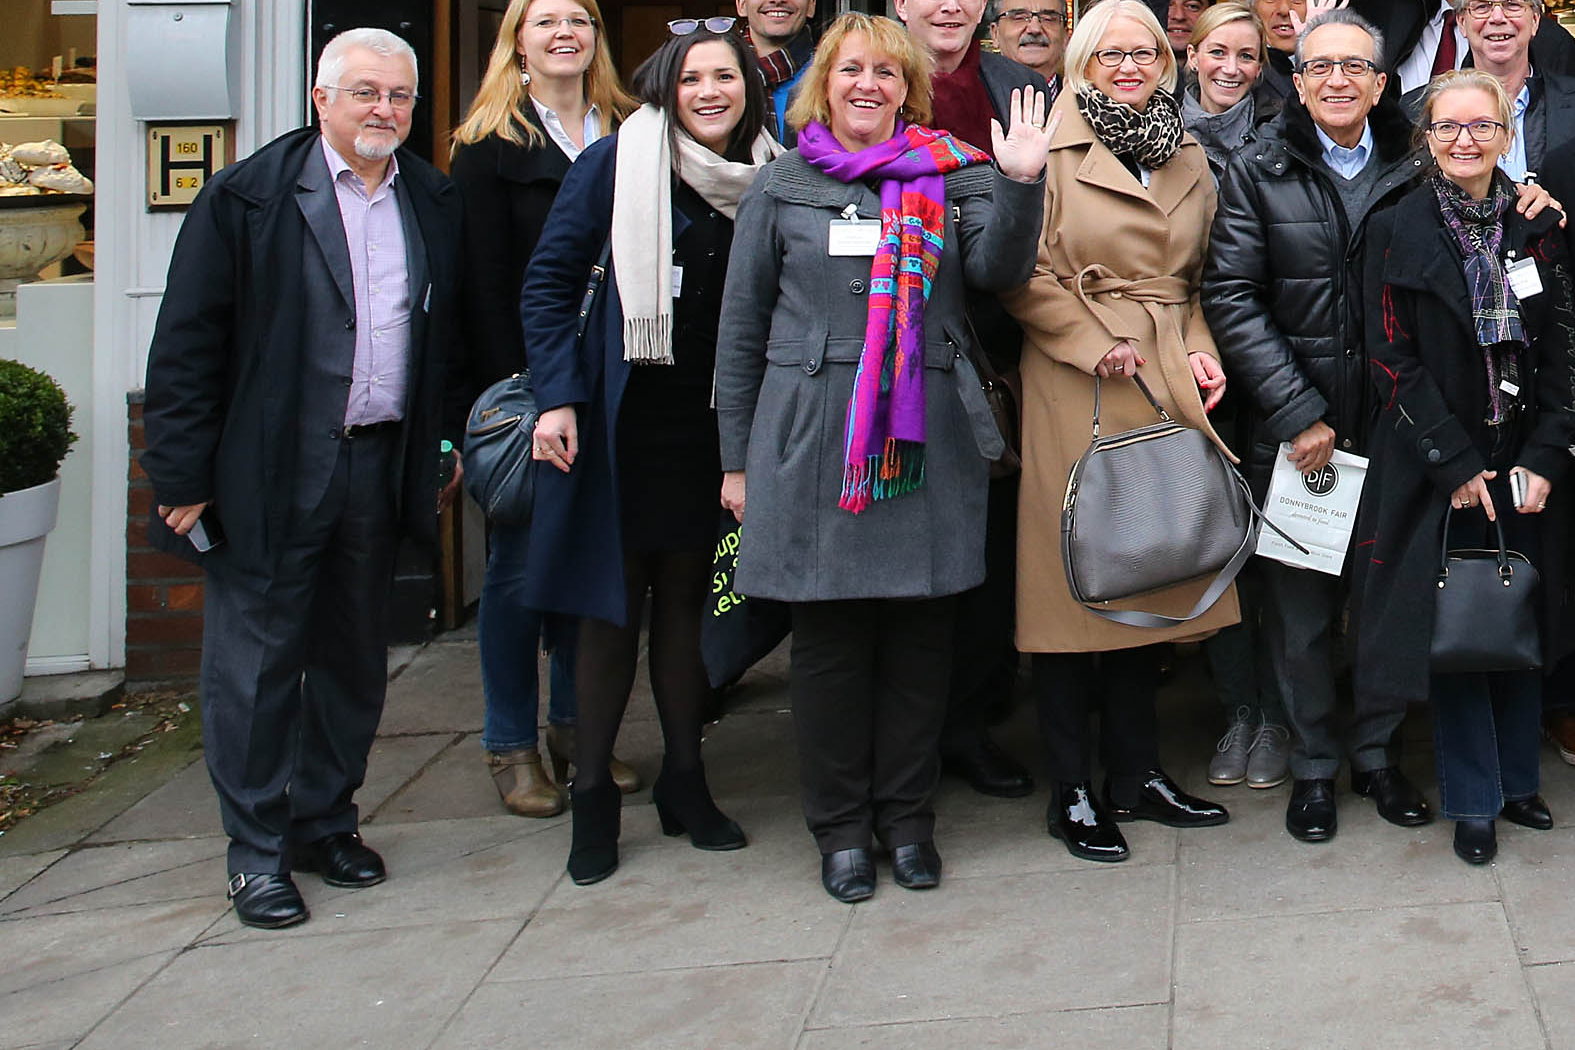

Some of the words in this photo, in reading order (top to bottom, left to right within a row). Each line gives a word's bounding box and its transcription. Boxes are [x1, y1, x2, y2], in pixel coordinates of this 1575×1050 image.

[177, 142, 198, 153] 160
[1279, 496, 1329, 515] DONNYBROOK
[1330, 510, 1348, 519] FAIR
